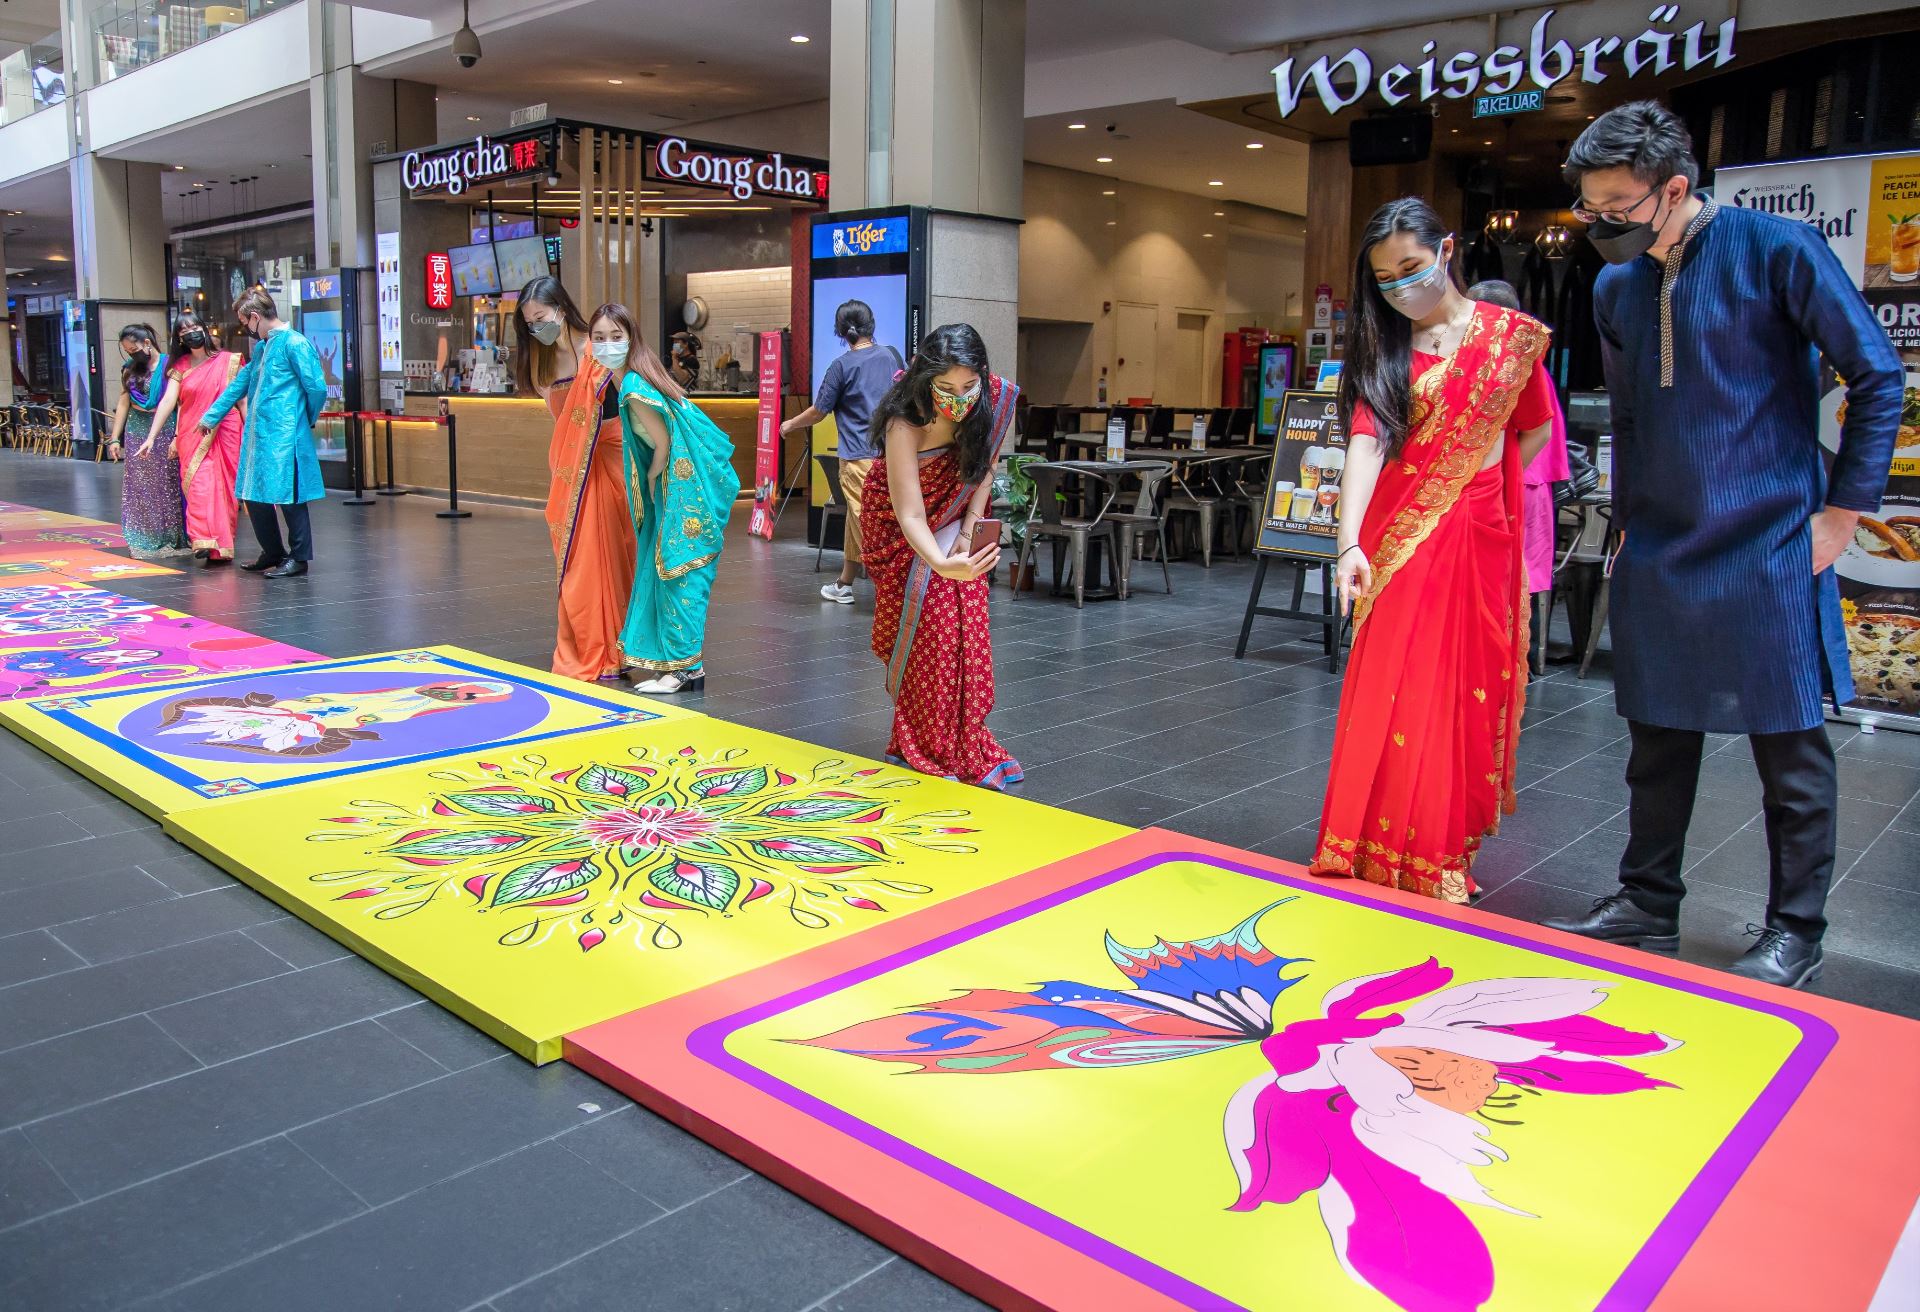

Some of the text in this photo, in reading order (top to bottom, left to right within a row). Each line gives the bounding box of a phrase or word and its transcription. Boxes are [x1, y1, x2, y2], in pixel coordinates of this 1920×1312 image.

[1270, 4, 1737, 119] Weissbräu
[1490, 93, 1539, 112] KELUAR
[402, 135, 508, 195] Gong cha
[512, 140, 536, 169] 貢茶
[658, 137, 813, 200] Gong cha
[815, 172, 830, 199] 貢
[1882, 192, 1899, 201] ICE
[1883, 181, 1918, 191] PEACH
[847, 222, 887, 252] Tiger
[315, 276, 332, 297] Tiger
[430, 255, 448, 306] 貢茶
[1868, 303, 1920, 327] OR
[1905, 339, 1920, 347] ME
[1287, 417, 1326, 431] HAPPY
[1285, 429, 1318, 442] HOUR
[1267, 520, 1284, 528] SAVE
[1285, 521, 1307, 531] WATER
[1308, 524, 1330, 534] DRINK
